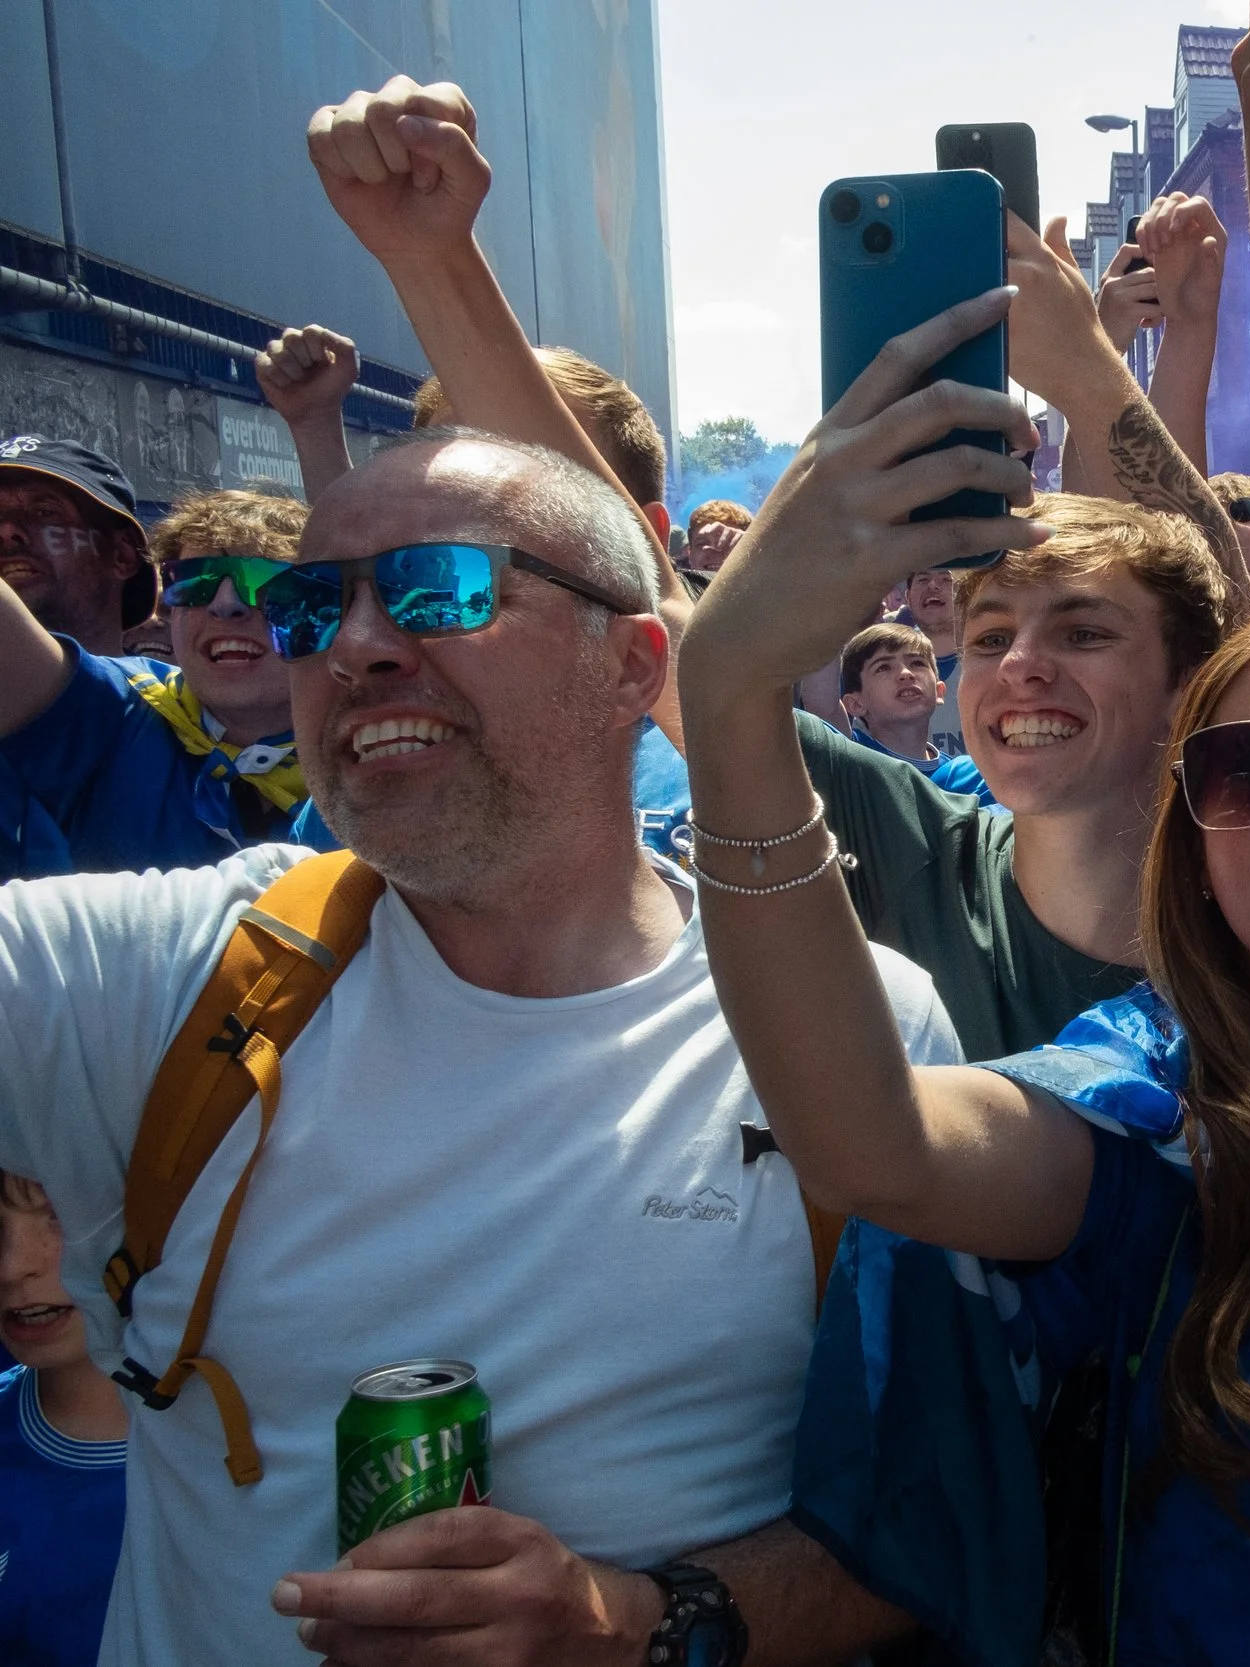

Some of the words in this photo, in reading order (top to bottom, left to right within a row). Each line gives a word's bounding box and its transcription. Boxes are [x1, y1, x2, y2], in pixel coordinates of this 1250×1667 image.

[222, 415, 279, 452] everton
[239, 452, 301, 487] communi
[641, 1195, 688, 1220] Peter
[688, 1200, 738, 1222] Storm
